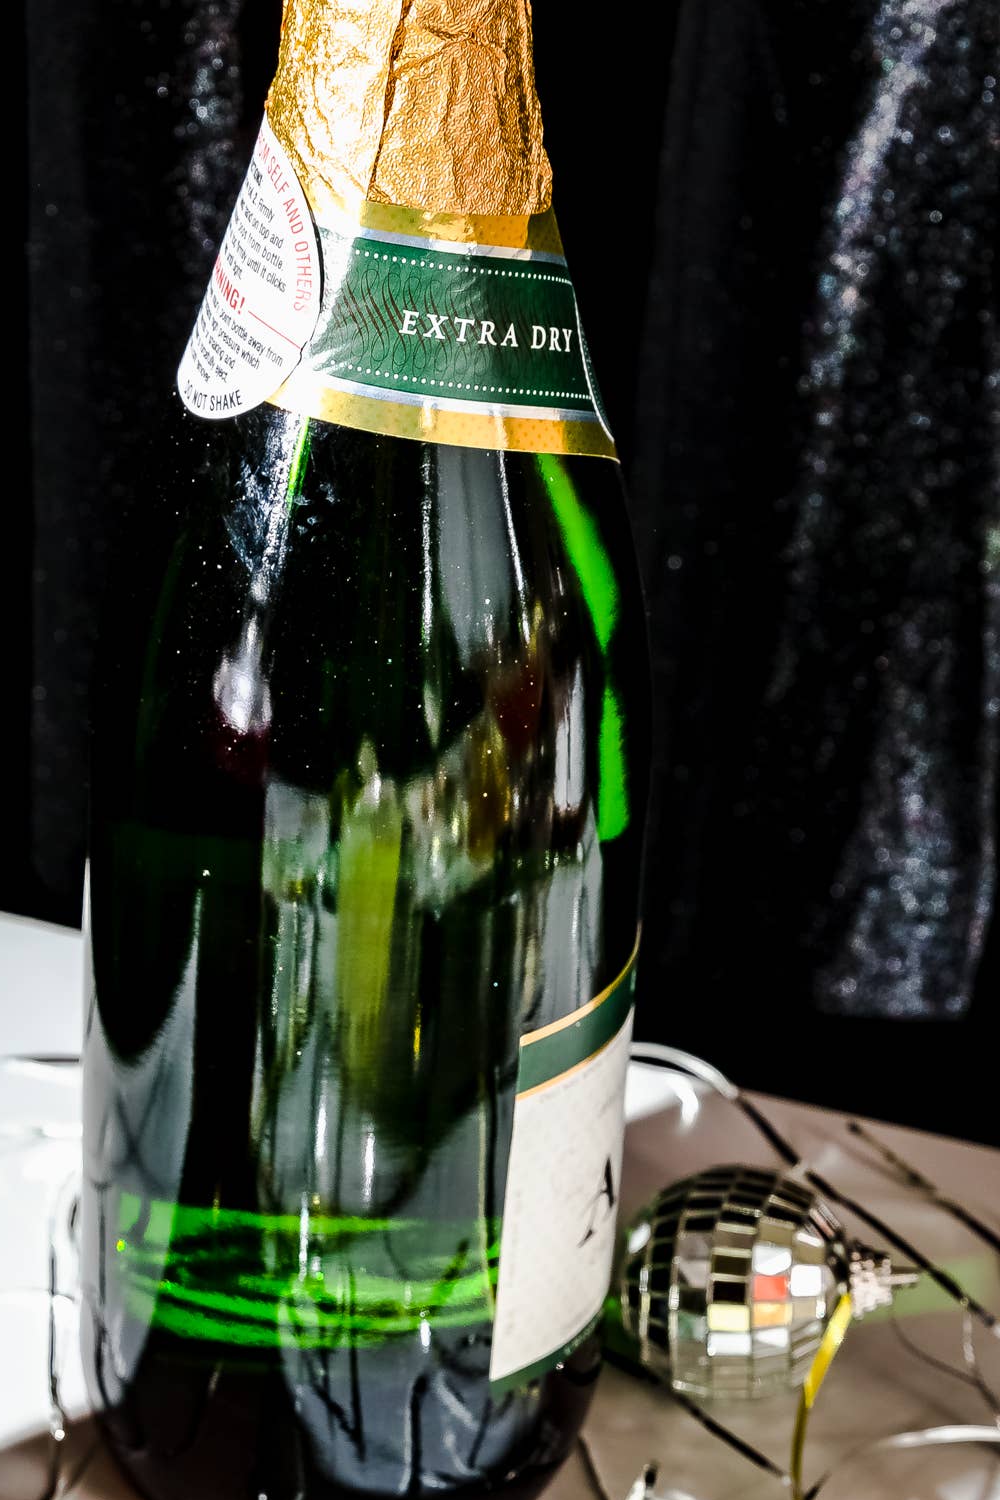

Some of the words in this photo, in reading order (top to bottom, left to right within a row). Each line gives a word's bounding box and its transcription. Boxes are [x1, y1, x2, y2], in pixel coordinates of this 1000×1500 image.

[268, 156, 290, 194] SELF
[283, 198, 304, 235] AND
[269, 233, 284, 249] and
[266, 271, 287, 293] clicks
[293, 241, 312, 311] OTHERS
[399, 309, 519, 348] EXTRA
[531, 325, 573, 353] DRY
[240, 349, 260, 370] which
[247, 336, 266, 356] away
[265, 347, 284, 367] from
[193, 392, 207, 410] NOT
[209, 389, 243, 411] SHAKE
